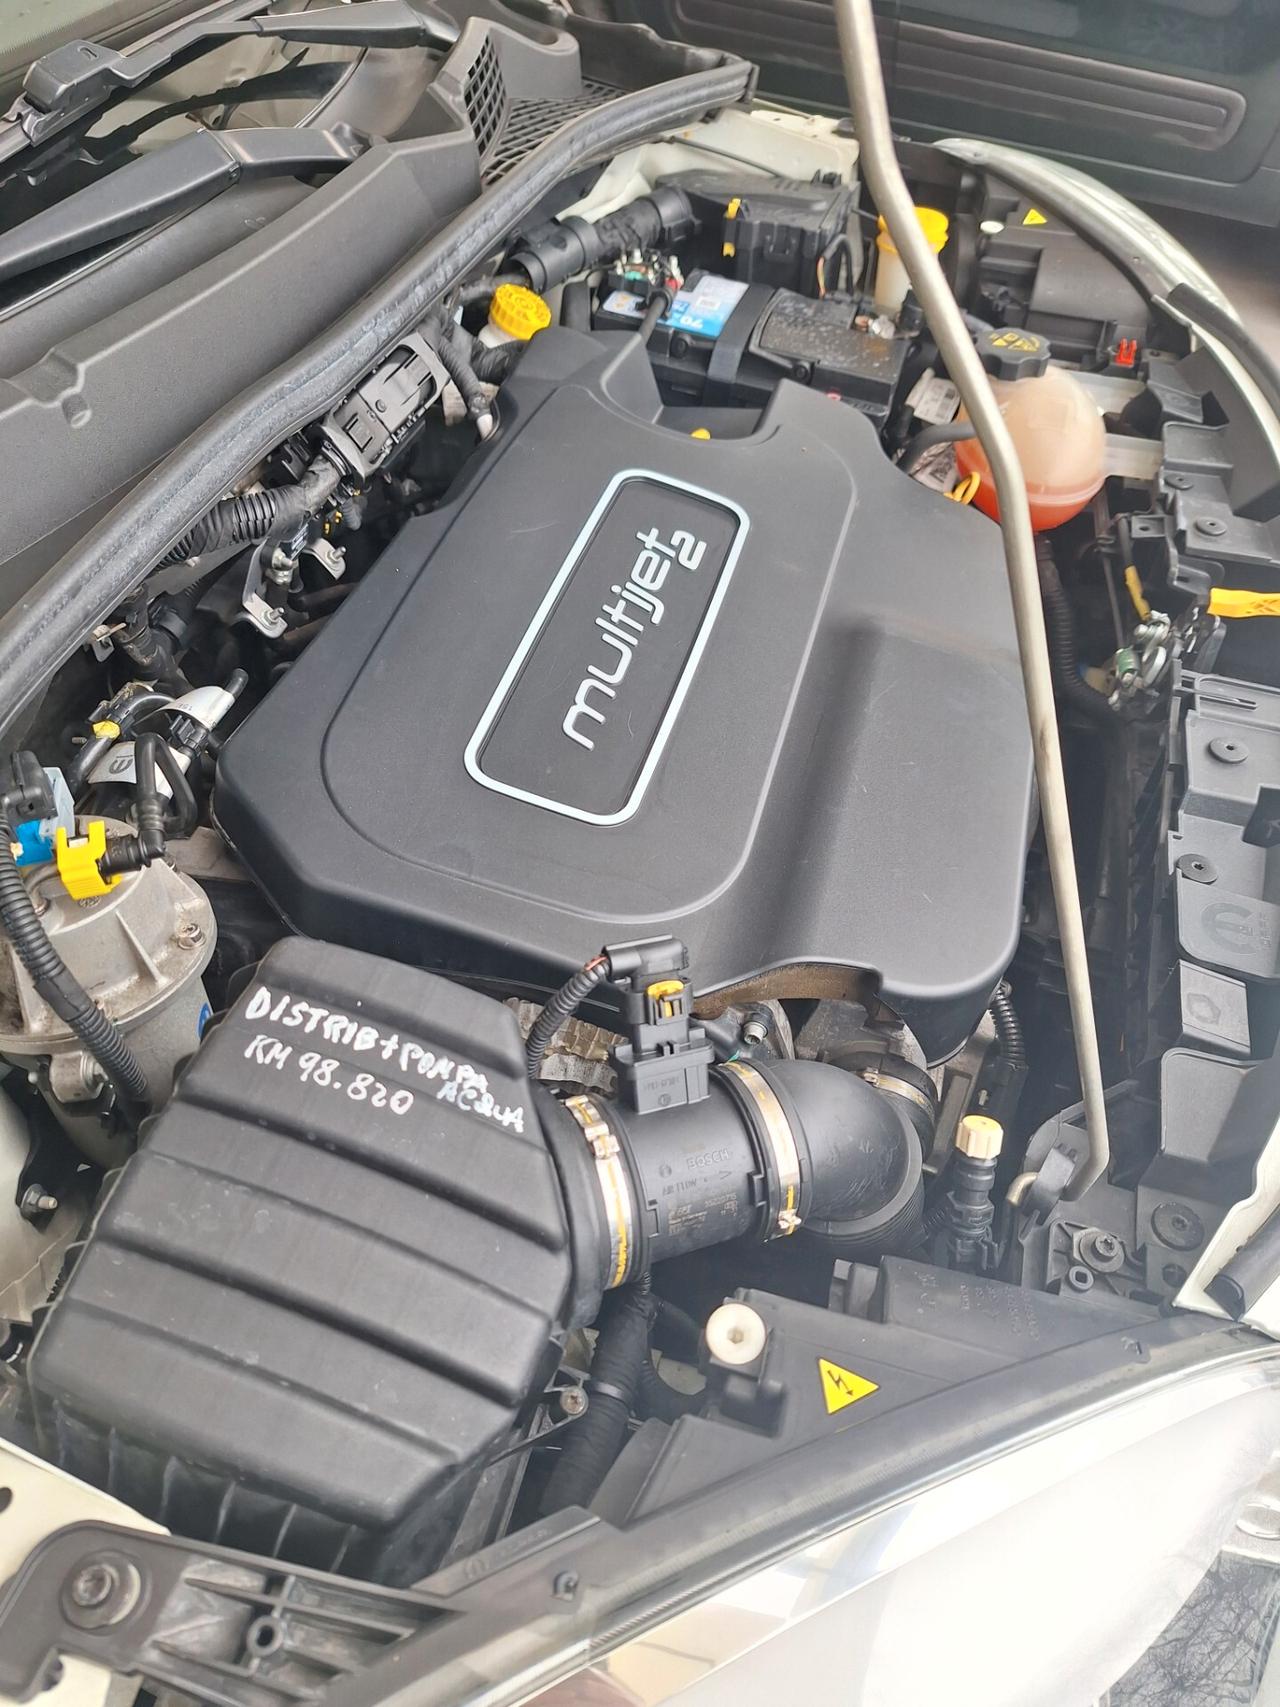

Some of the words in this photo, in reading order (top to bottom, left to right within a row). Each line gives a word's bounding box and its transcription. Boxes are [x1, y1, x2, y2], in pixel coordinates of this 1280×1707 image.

[245, 1035, 292, 1069] KM
[298, 1051, 415, 1115] 98.820
[686, 1148, 729, 1169] BOSCH
